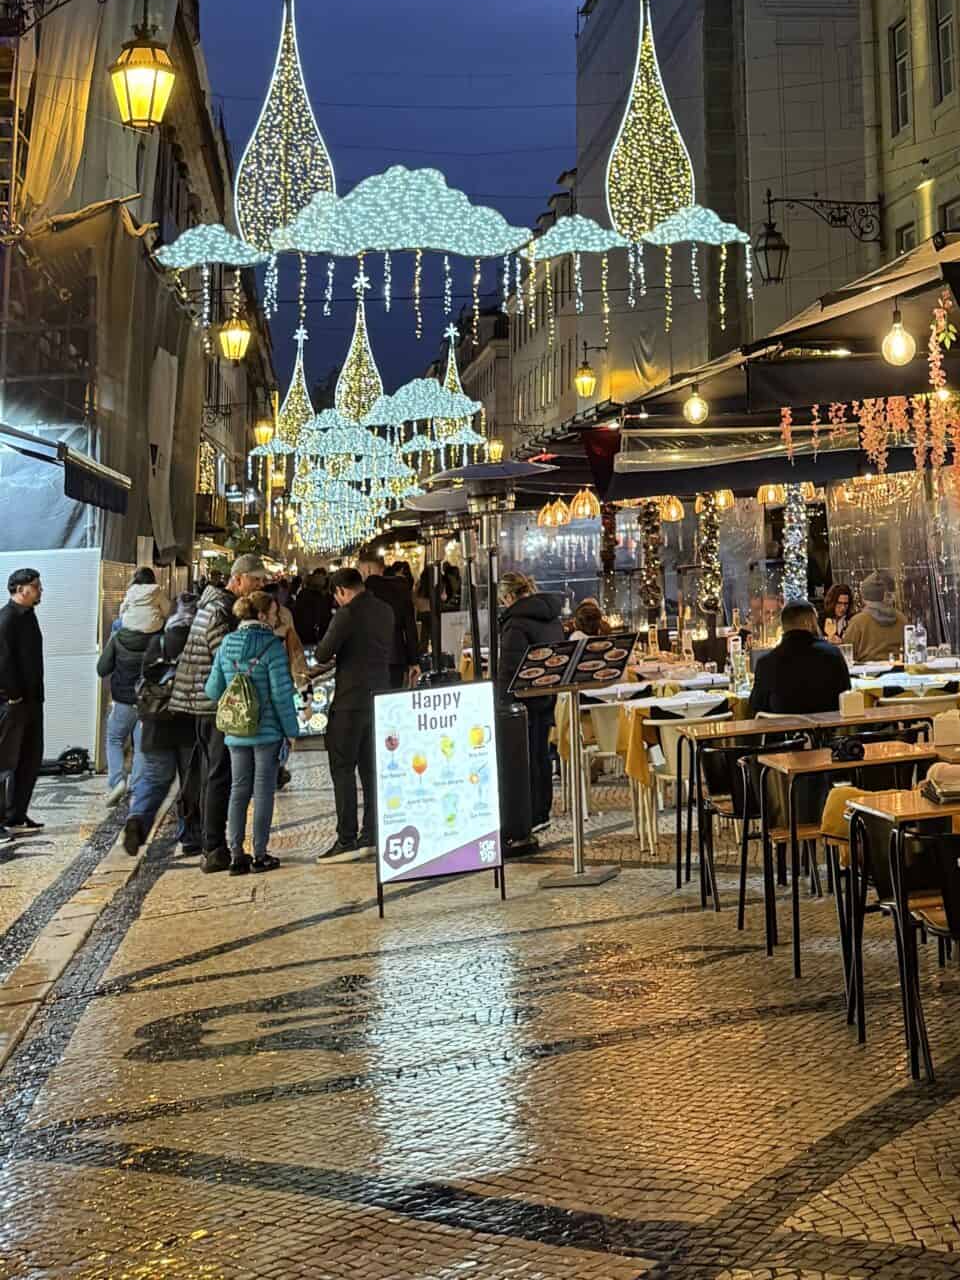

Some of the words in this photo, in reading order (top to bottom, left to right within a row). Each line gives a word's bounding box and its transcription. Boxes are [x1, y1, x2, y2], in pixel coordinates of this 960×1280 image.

[412, 691, 461, 711] Happy
[418, 713, 457, 731] Hour
[389, 836, 415, 860] 5€
